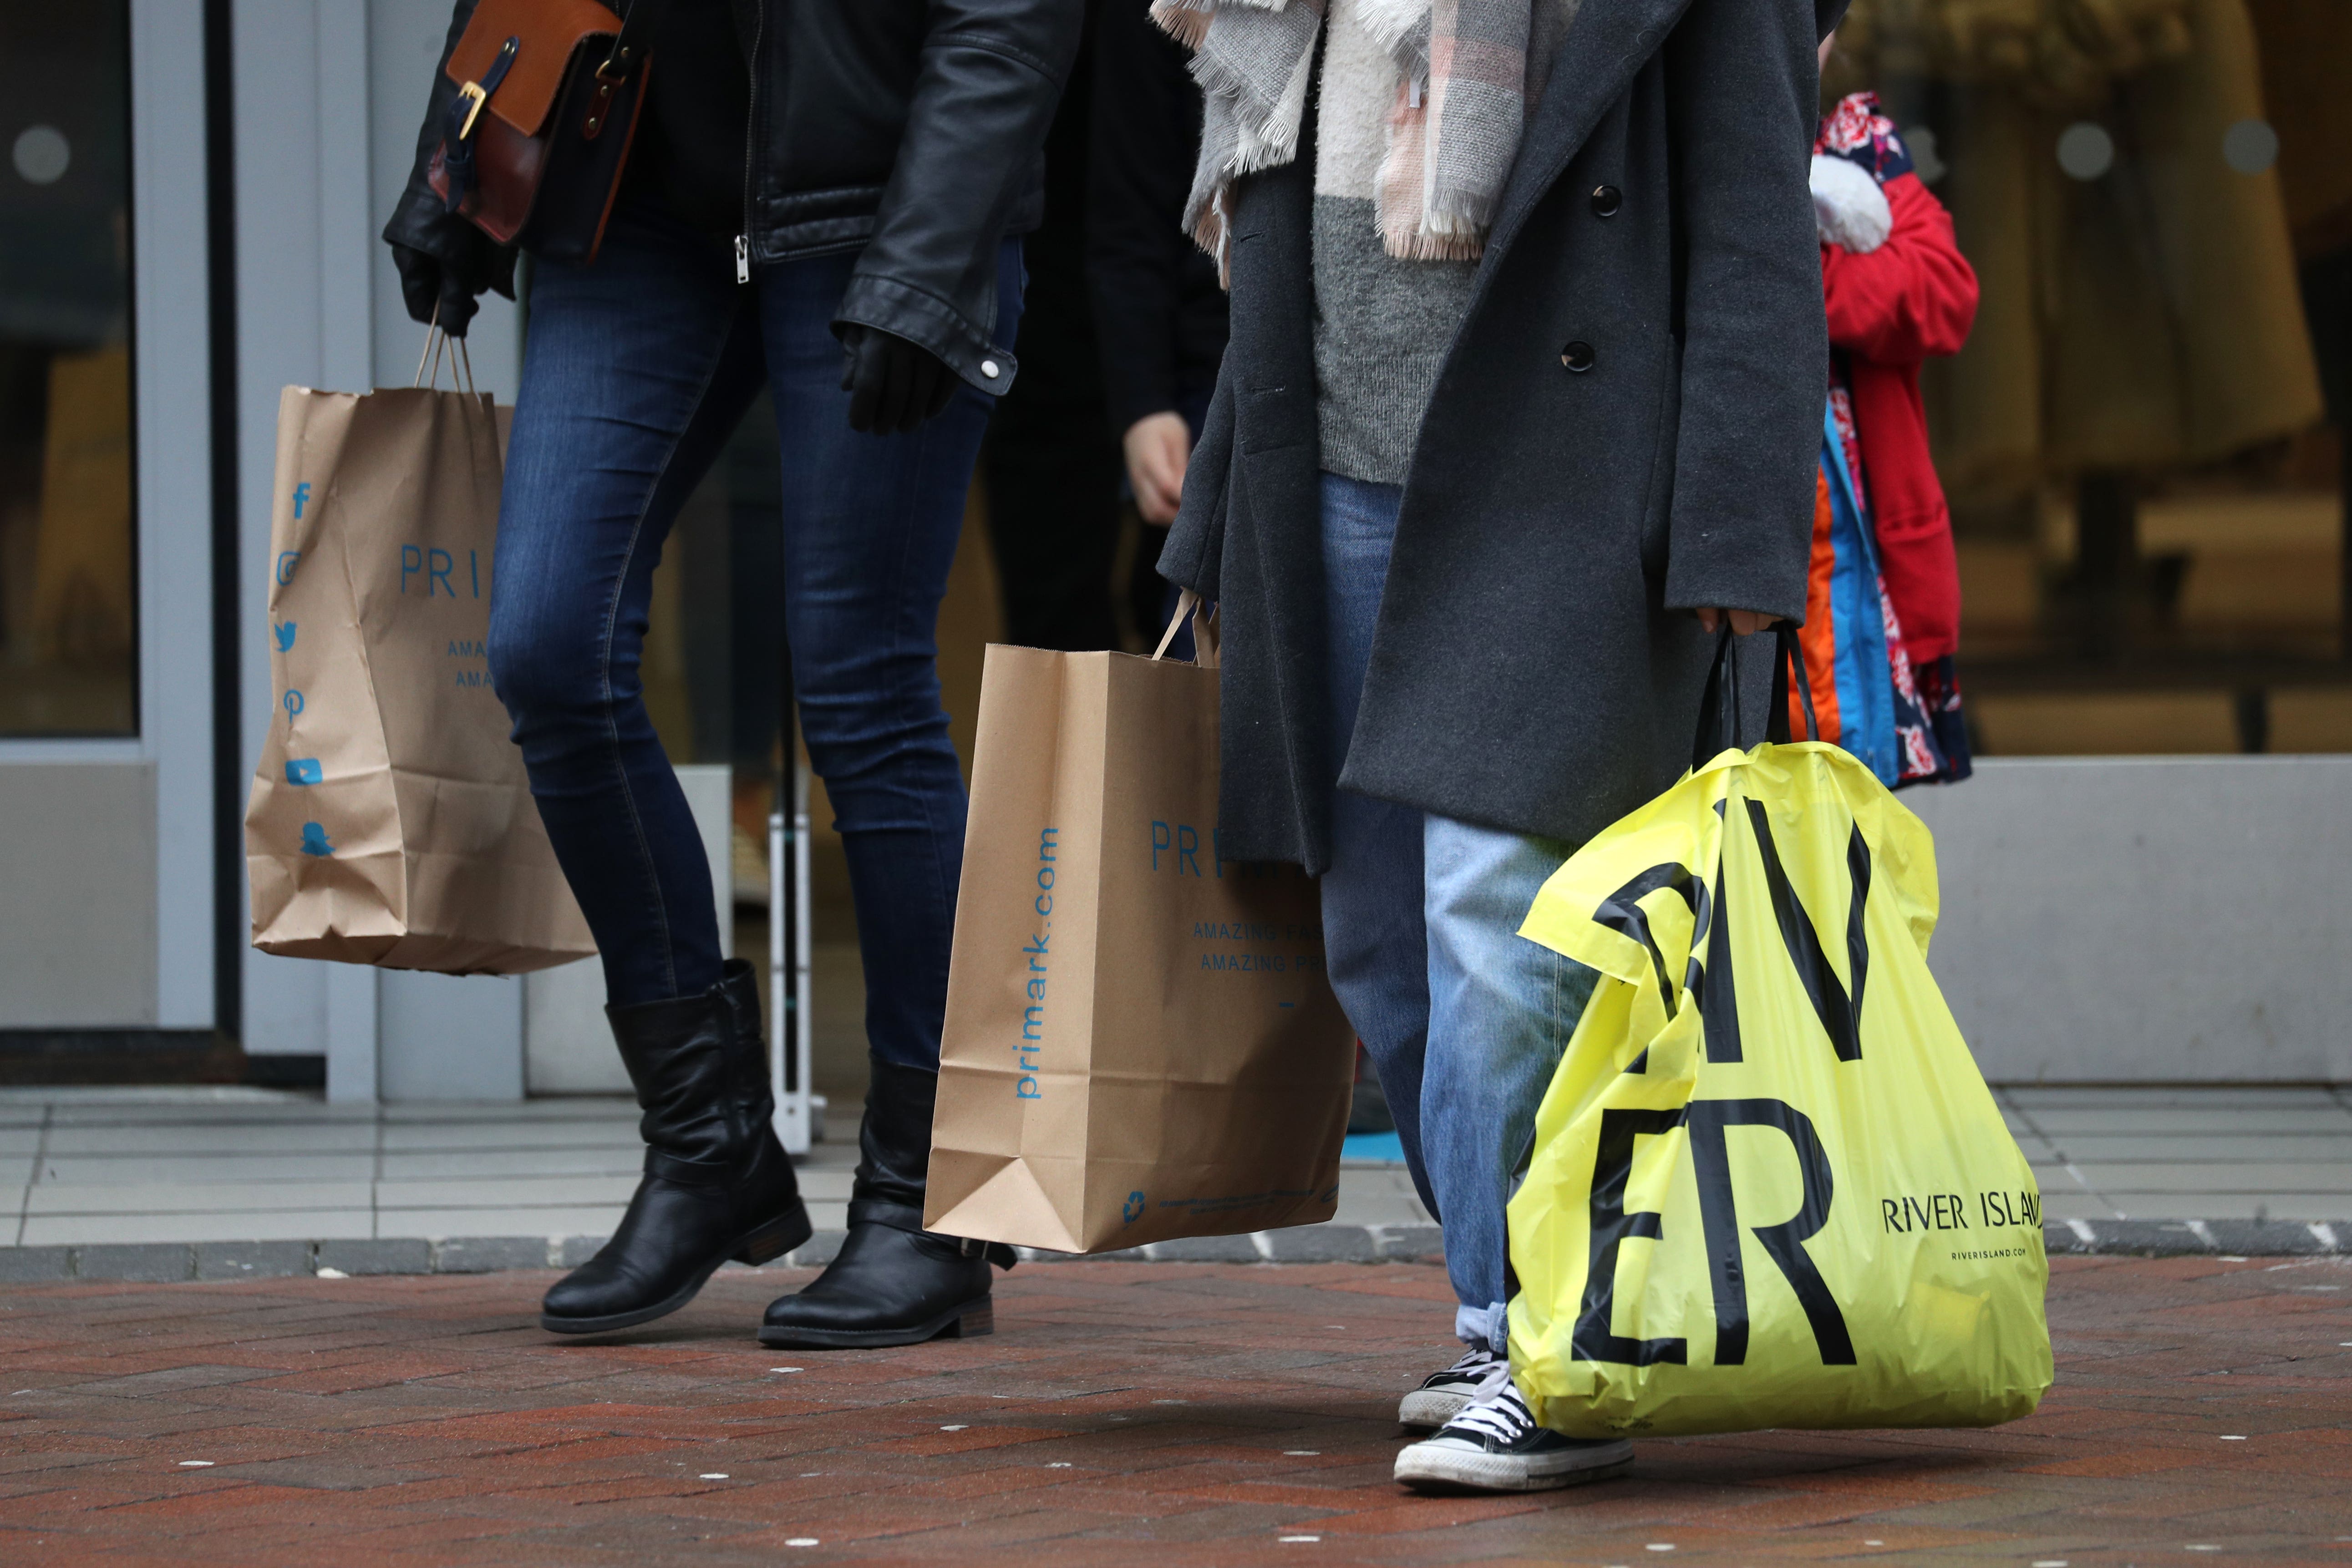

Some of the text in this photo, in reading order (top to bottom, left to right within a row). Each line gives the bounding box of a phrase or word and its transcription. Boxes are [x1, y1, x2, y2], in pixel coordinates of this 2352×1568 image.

[401, 545, 478, 599] PRI
[1194, 922, 1275, 941] AMAZING
[1012, 828, 1058, 1100] primark.com
[1201, 954, 1286, 972] AMAZING
[1571, 1098, 1858, 1367] ER
[1882, 1195, 1968, 1234] RIVER
[1951, 1248, 2026, 1260] RIVERISLAND.COM
